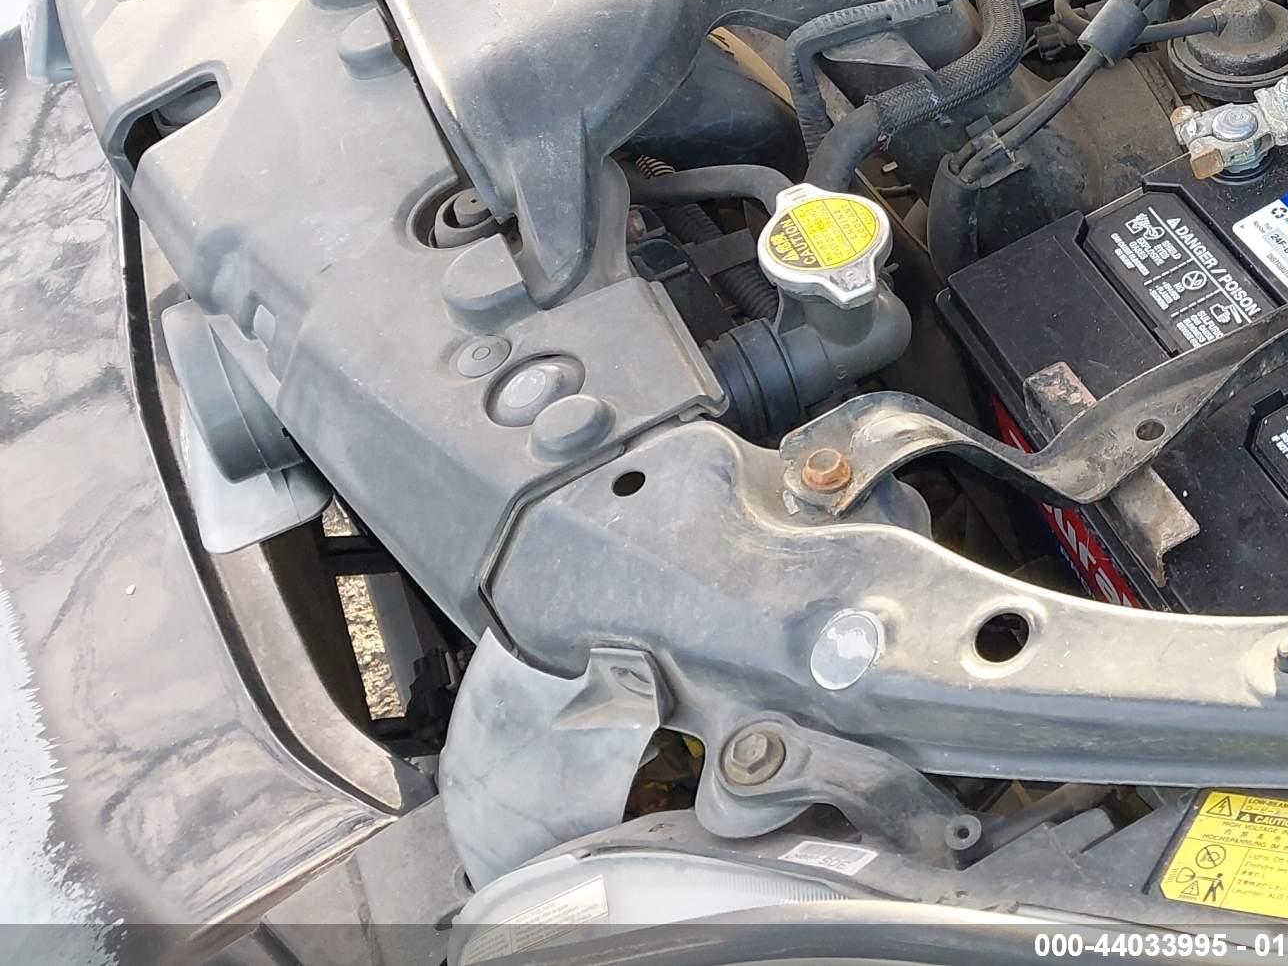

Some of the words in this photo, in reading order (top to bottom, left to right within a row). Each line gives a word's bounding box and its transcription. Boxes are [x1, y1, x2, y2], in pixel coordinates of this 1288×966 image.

[781, 219, 818, 264] CAUTION
[1129, 241, 1148, 260] GASES
[1162, 240, 1181, 259] SHIELD
[1137, 237, 1164, 266] EXPLOSIVE
[1154, 244, 1169, 259] EYES
[1176, 226, 1217, 268] DANGER
[1219, 274, 1260, 315] POISON
[1173, 282, 1185, 292] NO
[1197, 311, 1225, 339] SULFURIC
[1245, 825, 1278, 833] VOLTAGE
